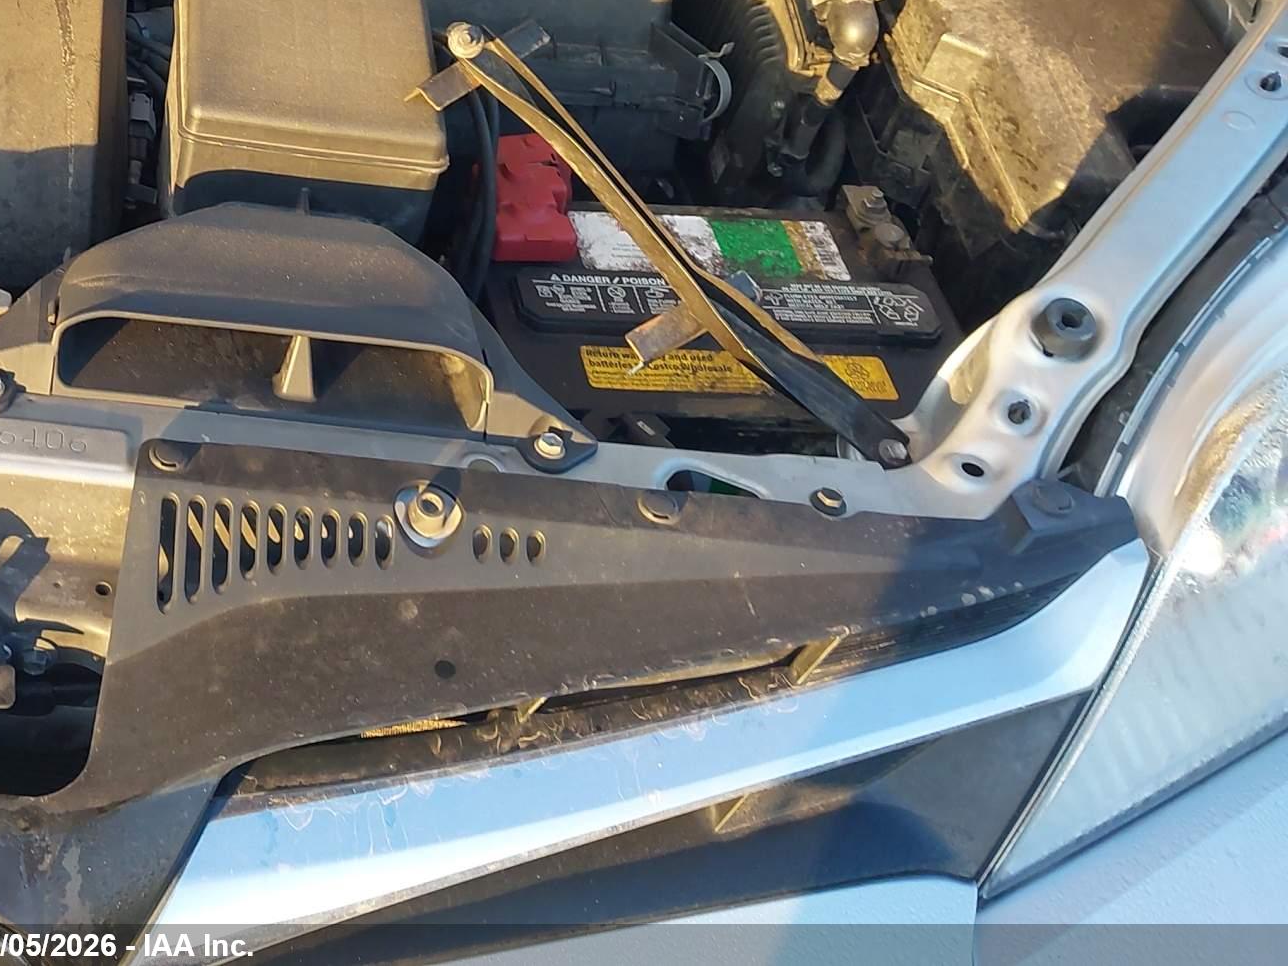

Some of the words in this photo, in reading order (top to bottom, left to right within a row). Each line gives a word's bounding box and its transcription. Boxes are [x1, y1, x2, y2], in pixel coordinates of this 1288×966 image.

[562, 274, 610, 284] DANGER
[622, 277, 666, 286] POISON
[668, 353, 688, 362] and
